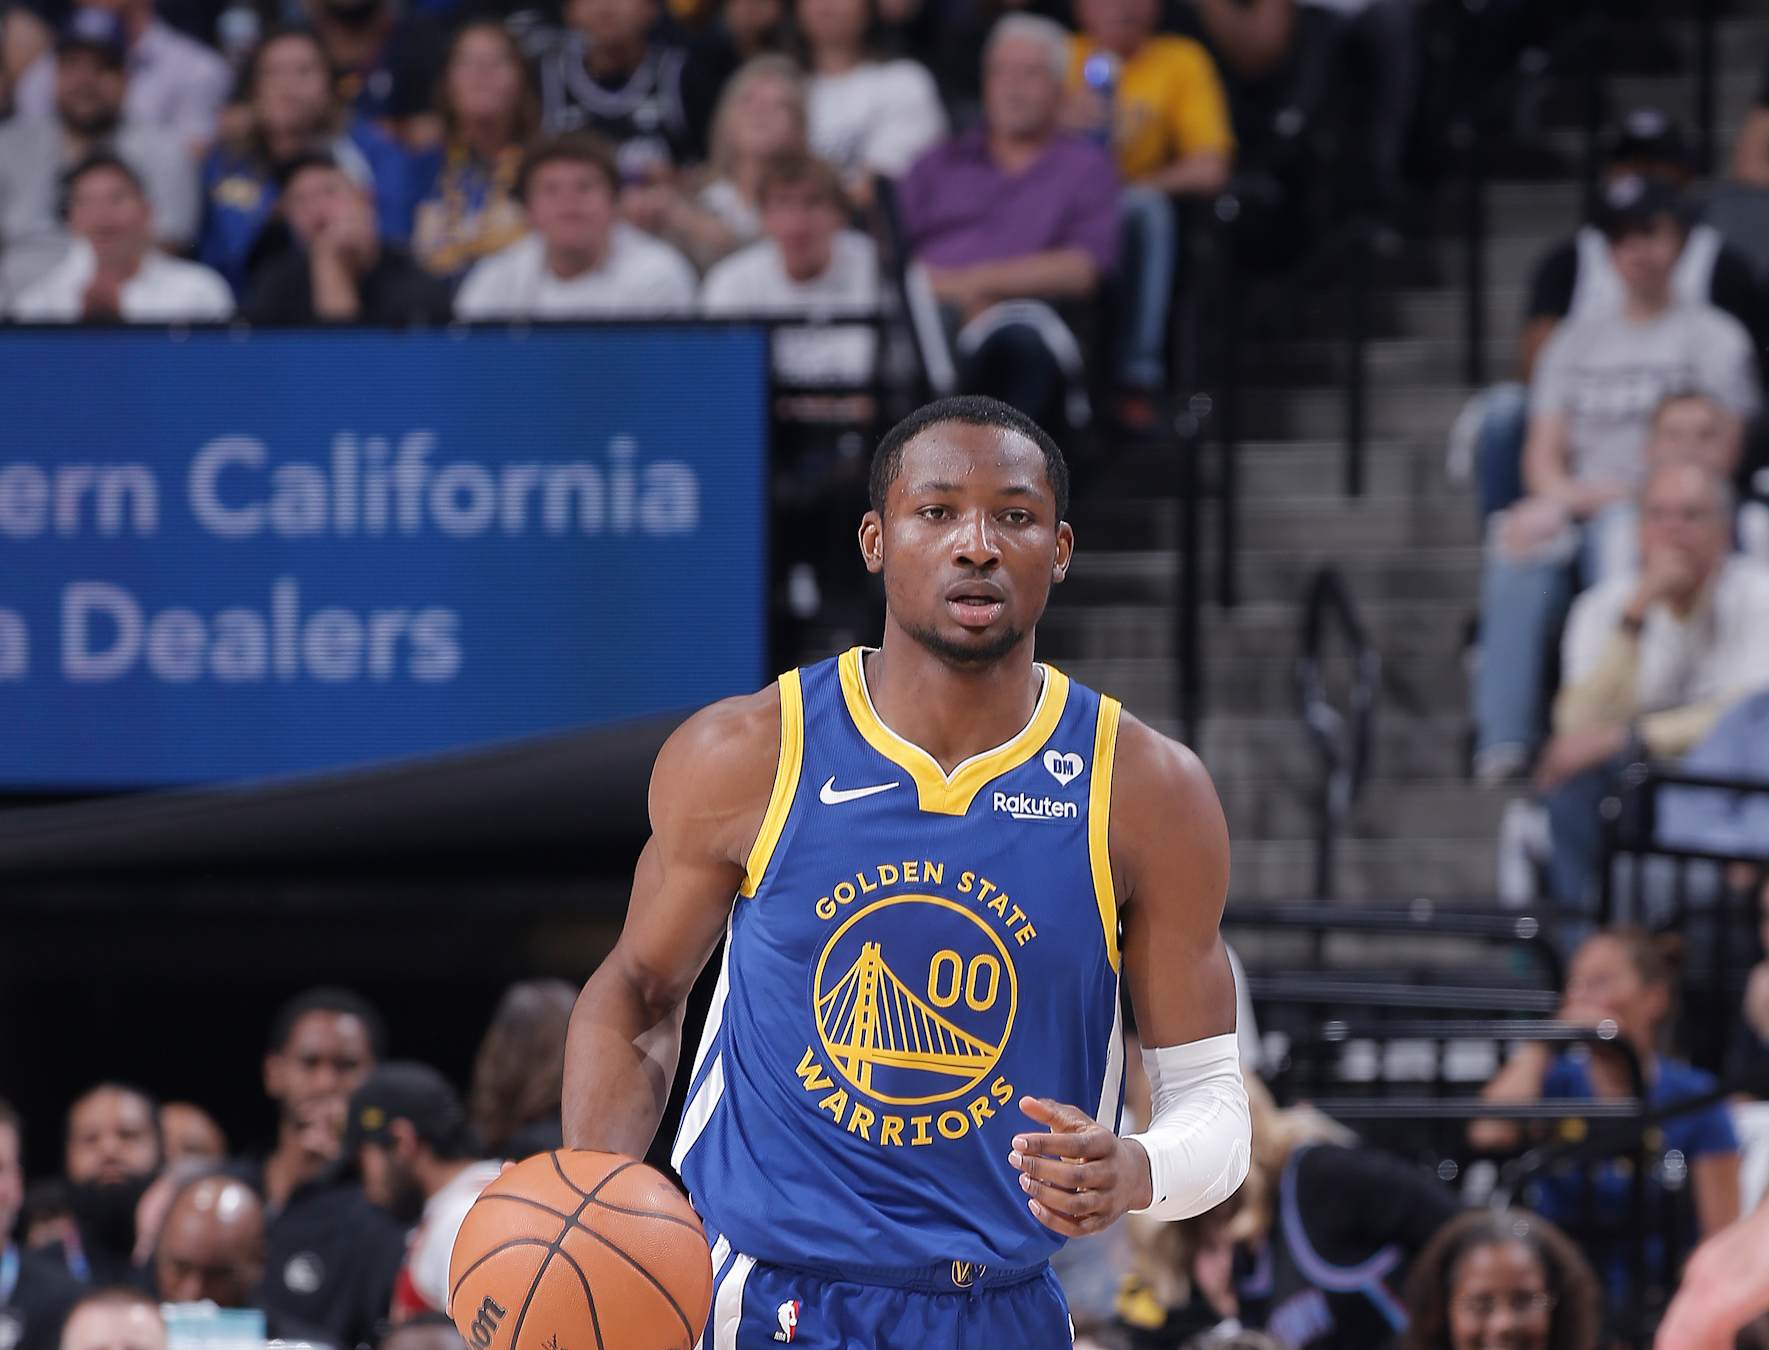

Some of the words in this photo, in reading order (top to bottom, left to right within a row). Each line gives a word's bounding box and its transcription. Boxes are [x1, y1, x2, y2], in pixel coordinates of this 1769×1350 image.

[0, 463, 159, 538] ern
[189, 430, 700, 539] California
[61, 578, 462, 682] Dealers
[993, 792, 1078, 819] Rakuten
[815, 861, 945, 920] GOLDEN
[956, 871, 1038, 946] STATE
[926, 949, 1001, 1012] 00
[795, 1045, 1015, 1147] WARRIORS
